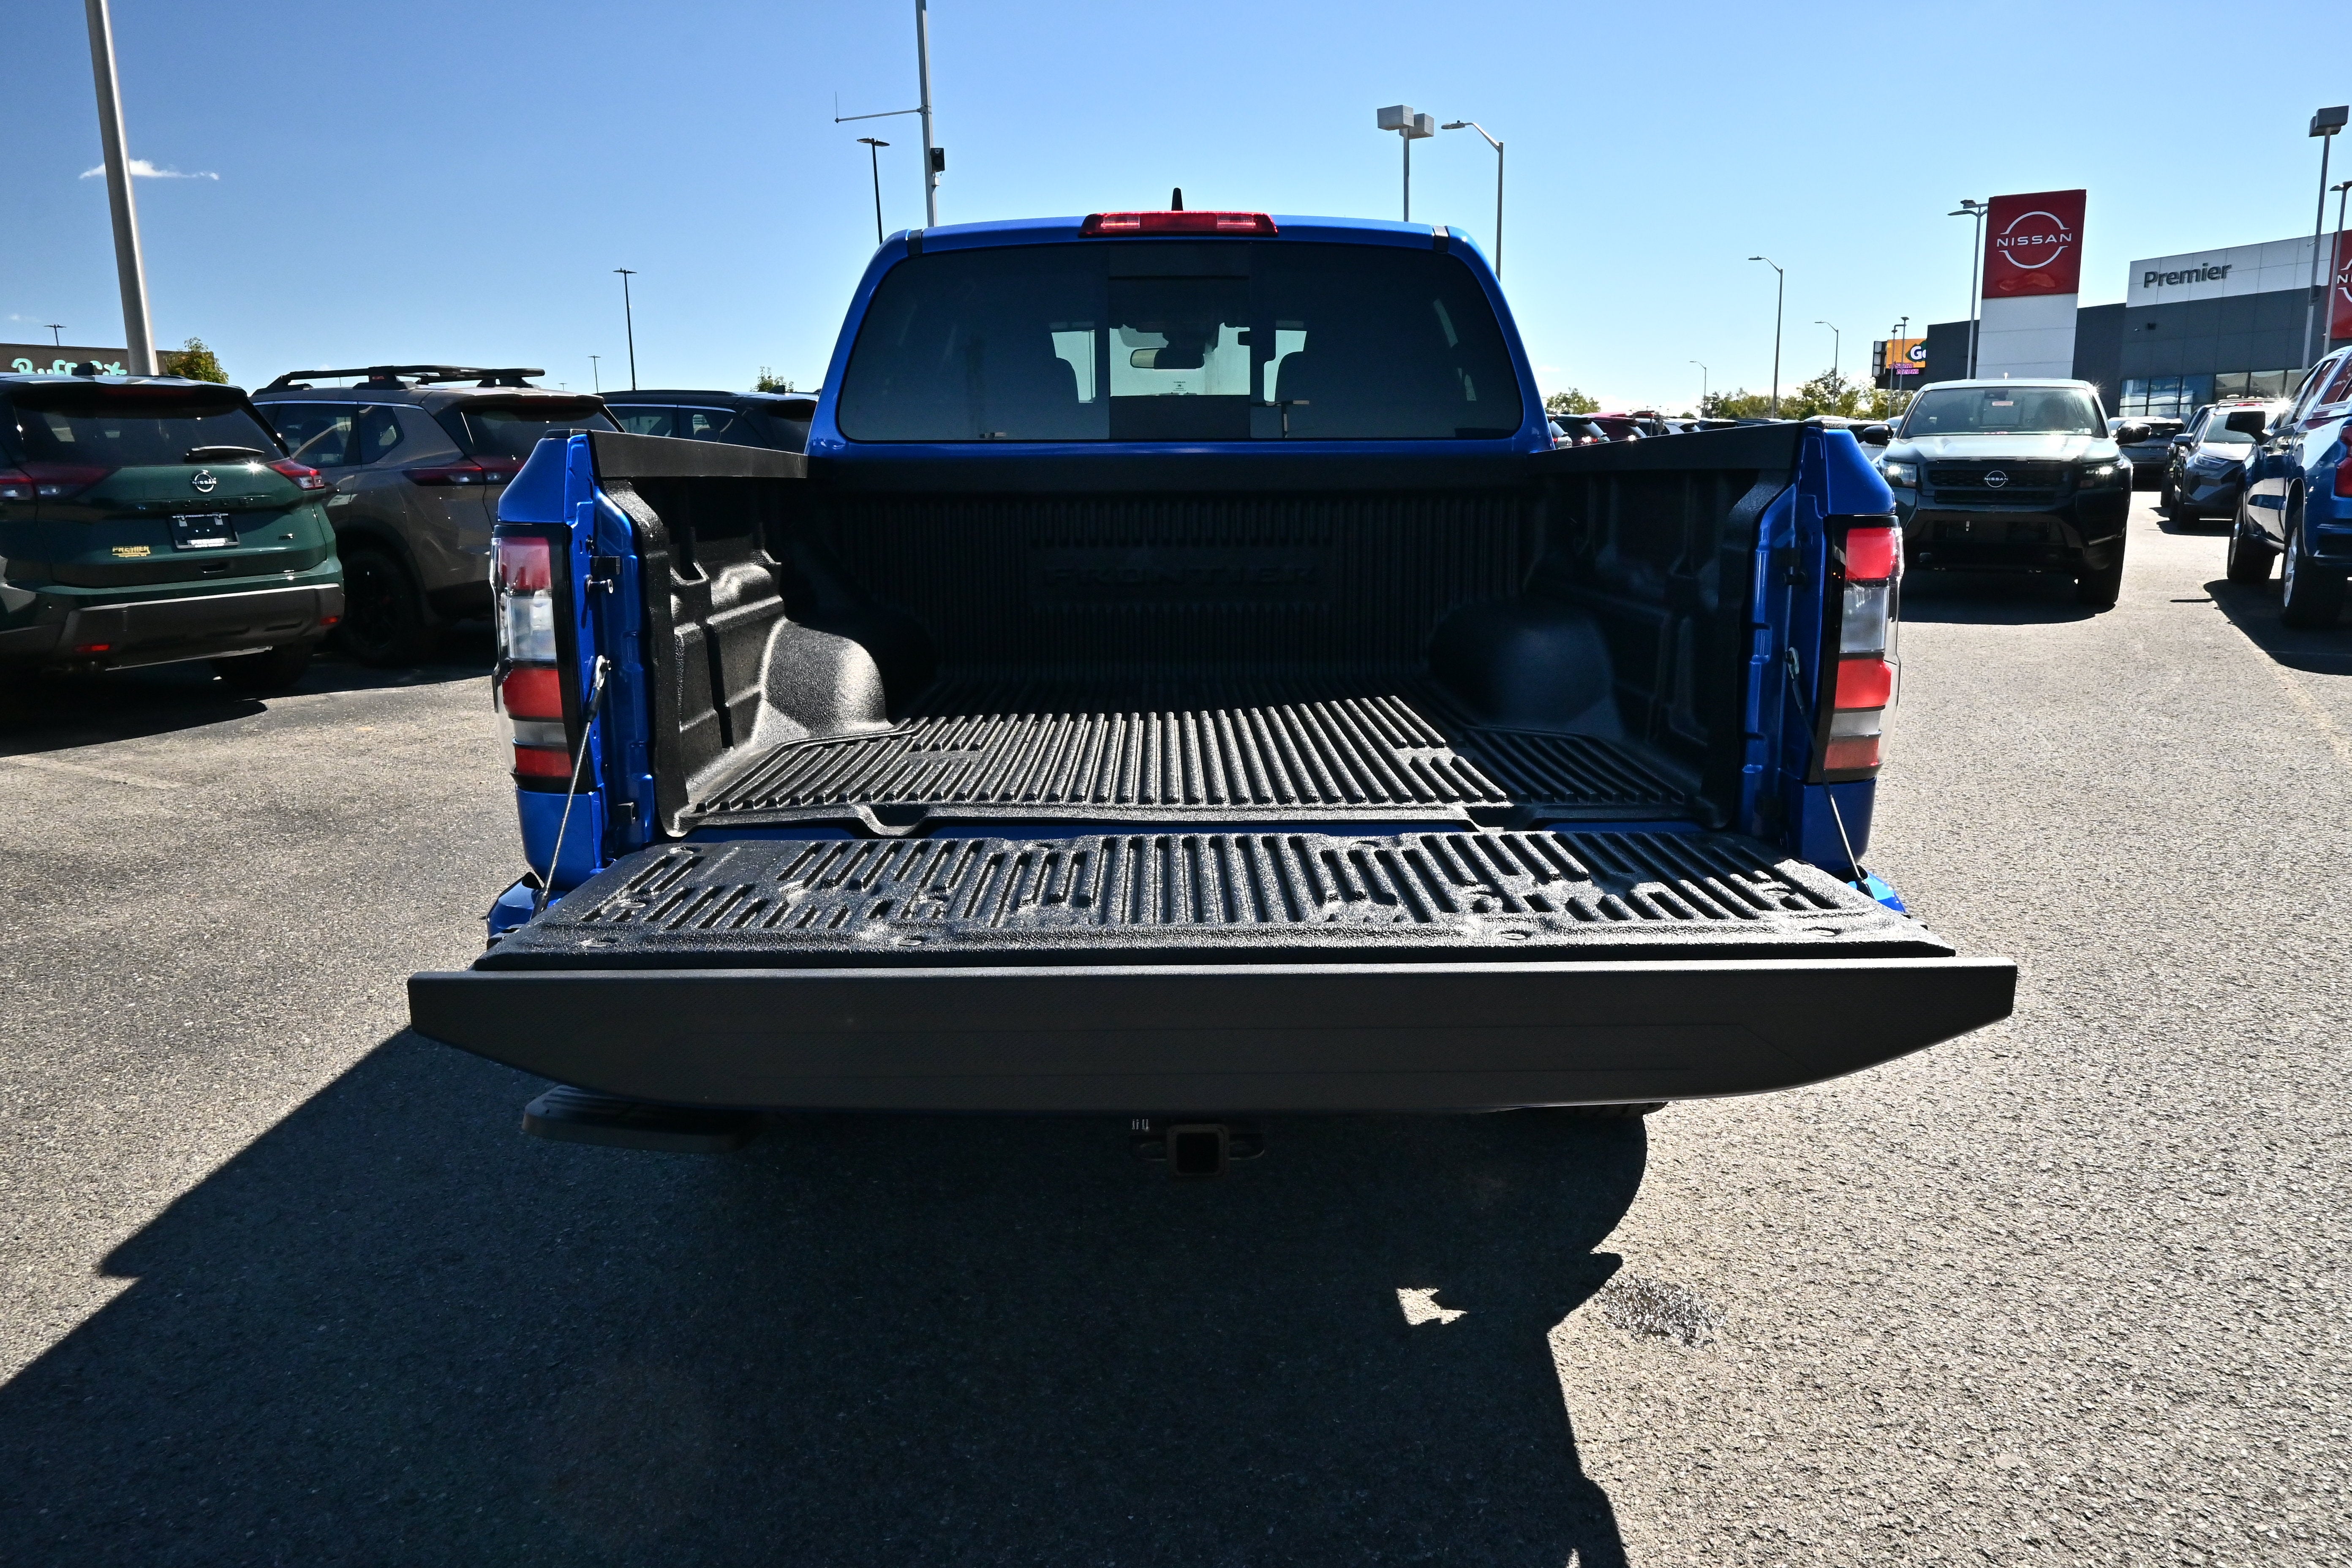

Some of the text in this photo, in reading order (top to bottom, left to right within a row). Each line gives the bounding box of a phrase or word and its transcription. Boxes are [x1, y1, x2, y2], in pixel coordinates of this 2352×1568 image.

[1996, 233, 2072, 247] NISSAN
[2144, 262, 2232, 288] Premier
[1043, 566, 1318, 587] FRONTIER
